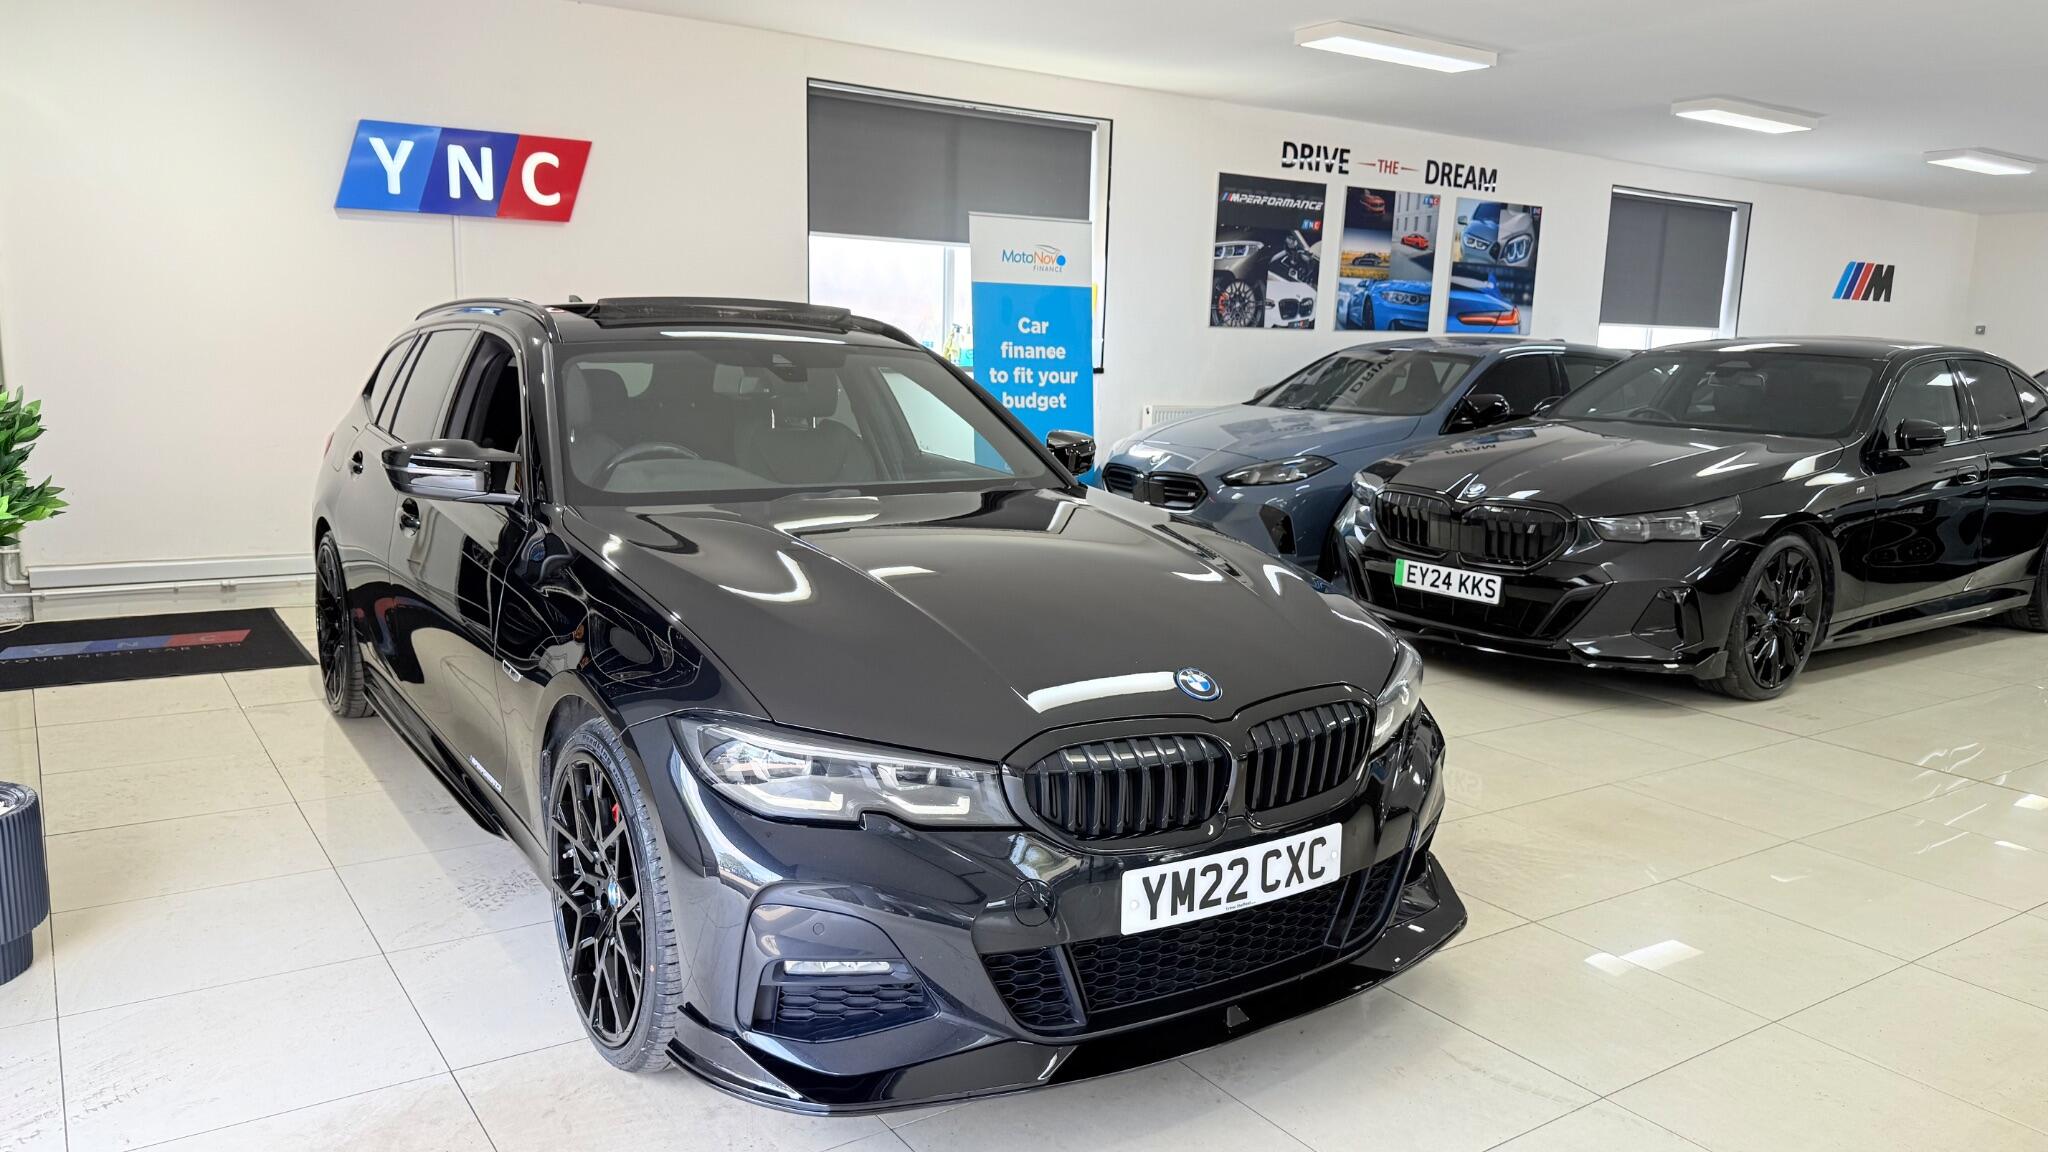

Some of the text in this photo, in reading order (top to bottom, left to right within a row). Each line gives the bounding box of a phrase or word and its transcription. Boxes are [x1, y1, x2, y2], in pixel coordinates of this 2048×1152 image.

[369, 136, 561, 206] YNC
[1281, 140, 1498, 192] DRIVE THE DREAM
[1002, 248, 1067, 266] MotoNovo
[1032, 264, 1063, 273] FINANCE
[1017, 317, 1050, 335] Car
[989, 366, 1079, 387] to fit your
[1002, 391, 1067, 412] budget
[1406, 564, 1497, 599] EY24 KKS
[1142, 836, 1327, 921] YM22 CXC
